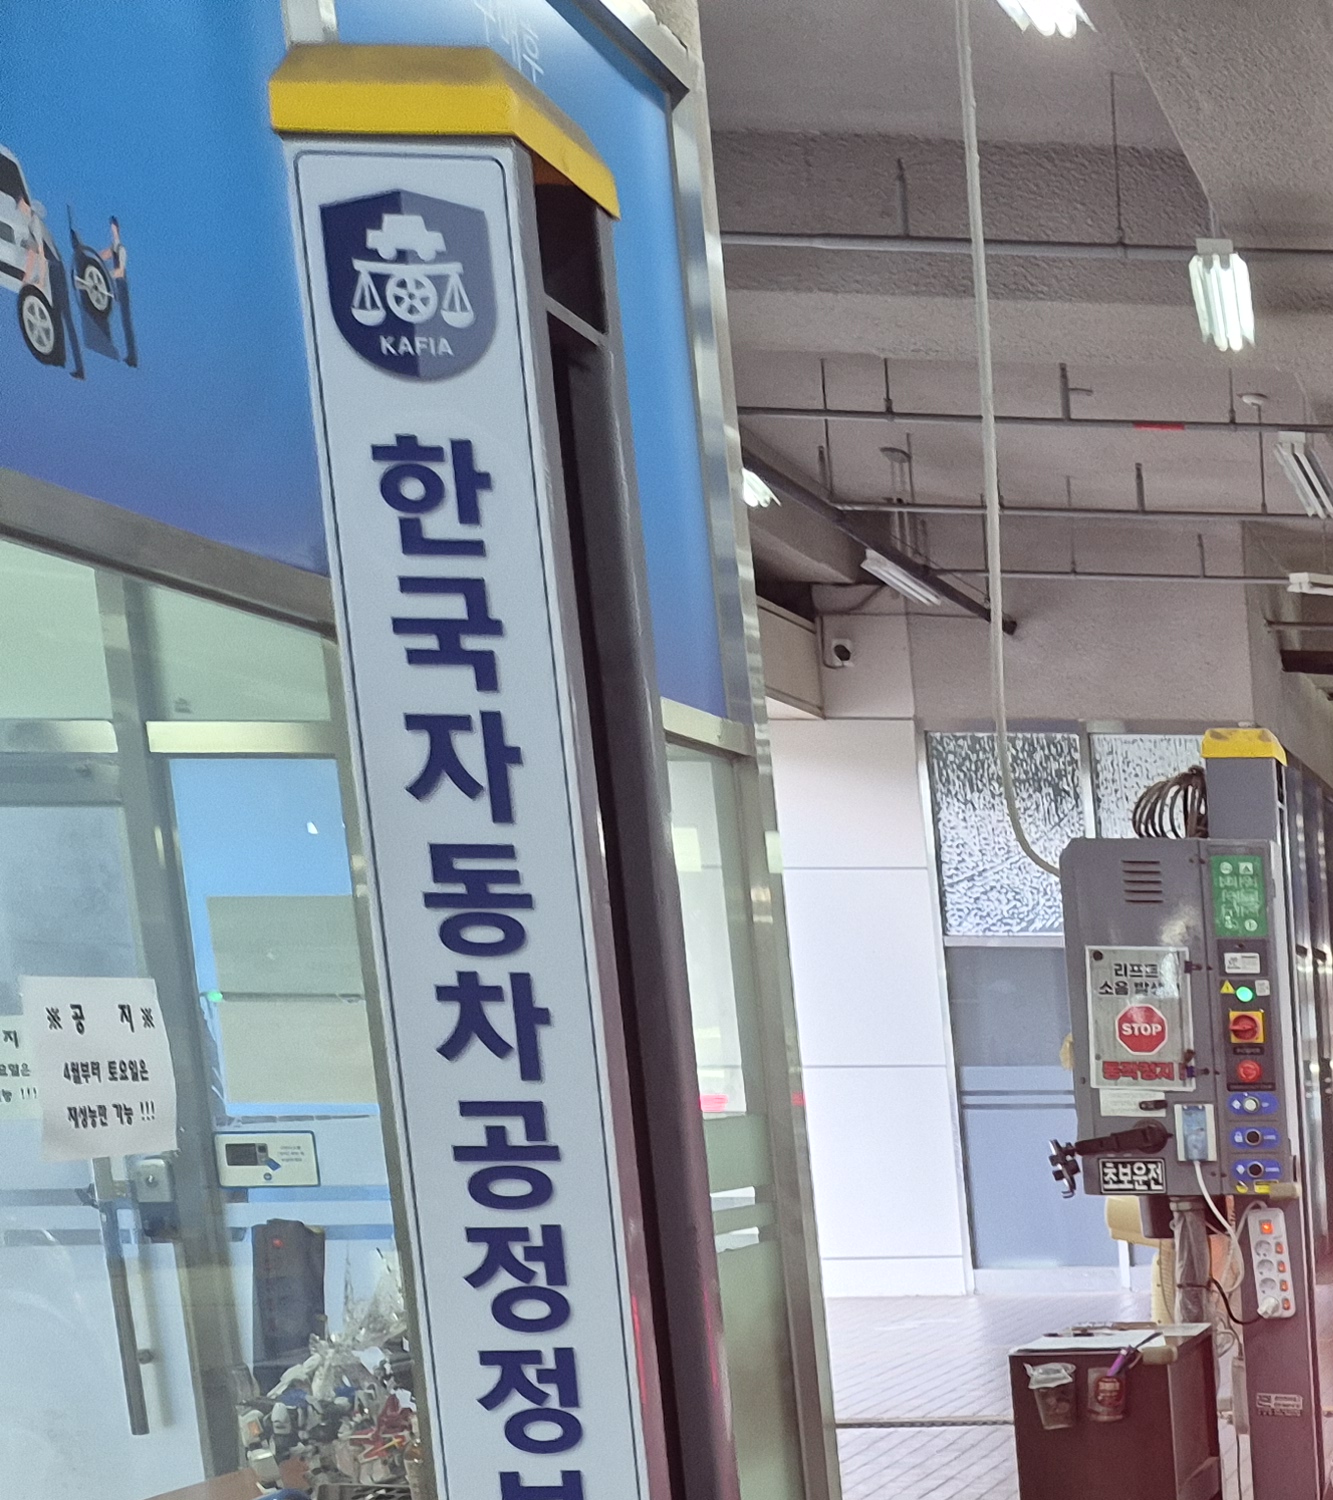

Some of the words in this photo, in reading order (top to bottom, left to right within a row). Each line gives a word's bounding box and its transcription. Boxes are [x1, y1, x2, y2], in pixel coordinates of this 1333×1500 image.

[379, 334, 455, 357] KAFIA
[1114, 963, 1158, 978] 리프트
[1098, 981, 1129, 996] 소음
[1121, 1023, 1162, 1036] STOP
[108, 1059, 149, 1082] 토요일은
[112, 1102, 134, 1125] 가능
[1103, 1162, 1163, 1190] 초보운전
